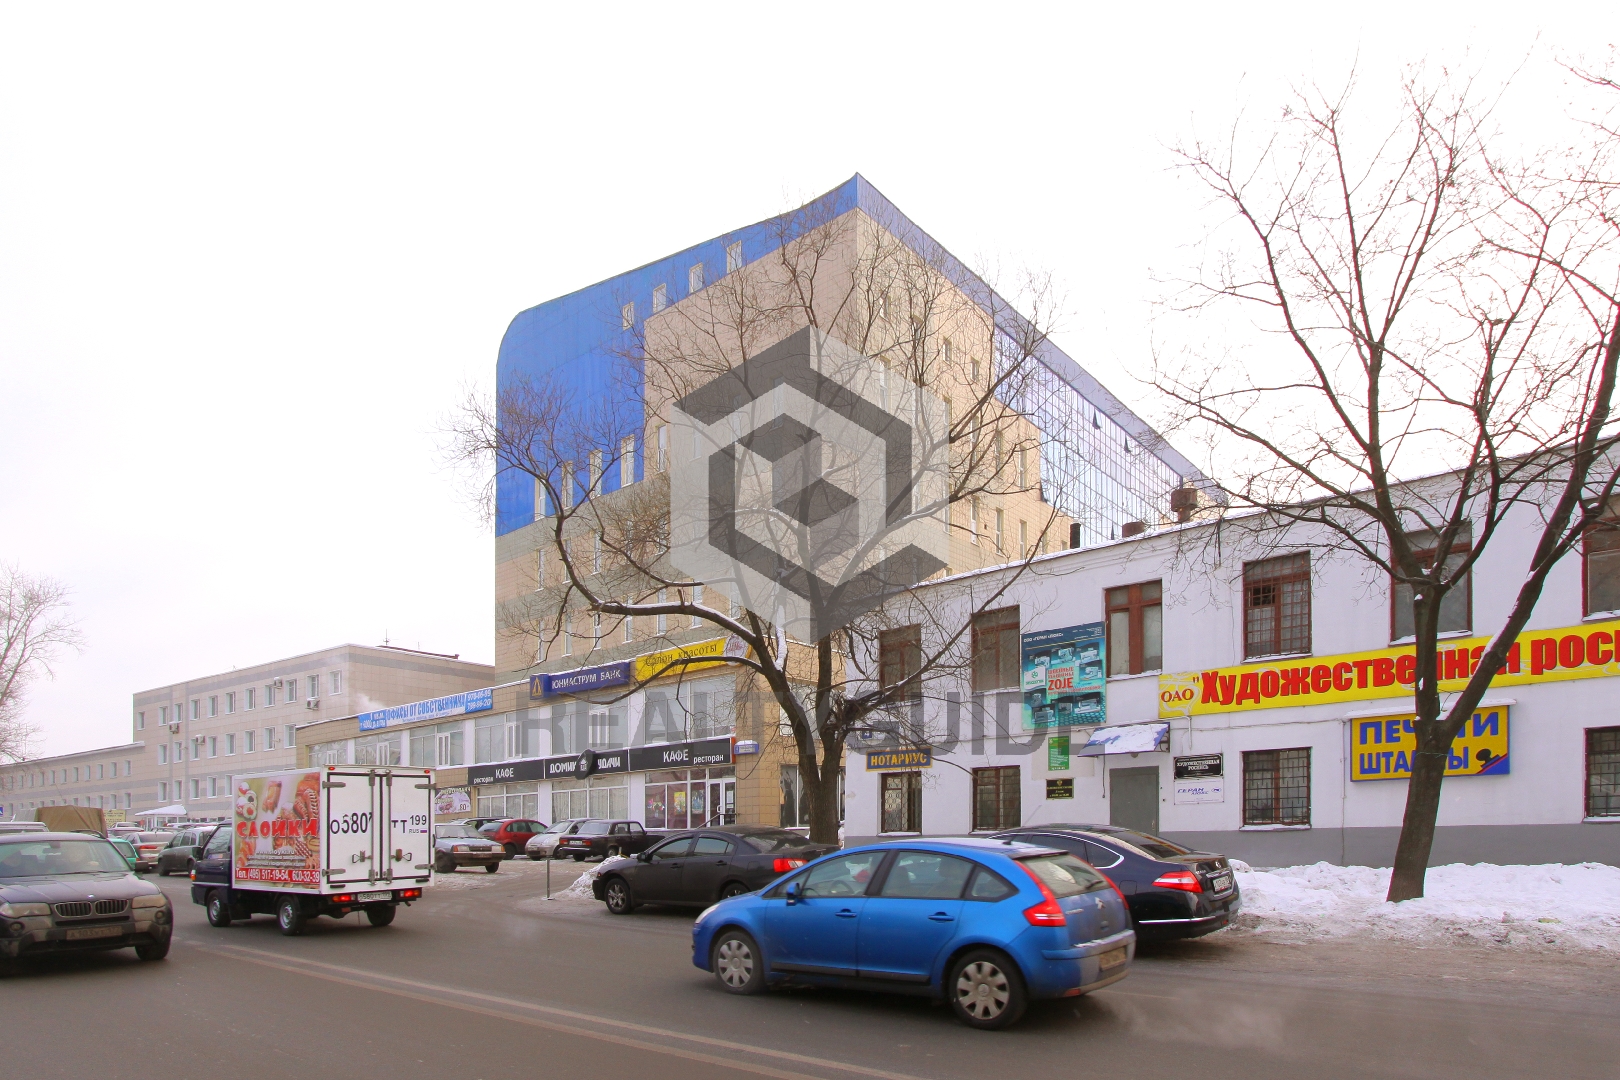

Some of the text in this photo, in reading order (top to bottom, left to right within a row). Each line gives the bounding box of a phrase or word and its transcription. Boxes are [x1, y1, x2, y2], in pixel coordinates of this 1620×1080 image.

[1160, 630, 1620, 706] ОАО "Художественя рос
[551, 669, 621, 690] ЮНИАСТРУМ БАНК
[1048, 677, 1074, 691] ZOJE
[386, 707, 409, 721] ОФИСЫ
[409, 703, 418, 717] ОТ
[597, 756, 621, 769] УДАЧИ
[663, 749, 724, 765] КАФЕ ресторан
[870, 753, 927, 767] НОТАРИУС
[1360, 746, 1469, 774] ШТАЫ
[495, 767, 514, 779] КАФЕ
[236, 815, 318, 838] СЛОЙКИ
[409, 814, 427, 826] 199
[236, 868, 247, 879] Тел.
